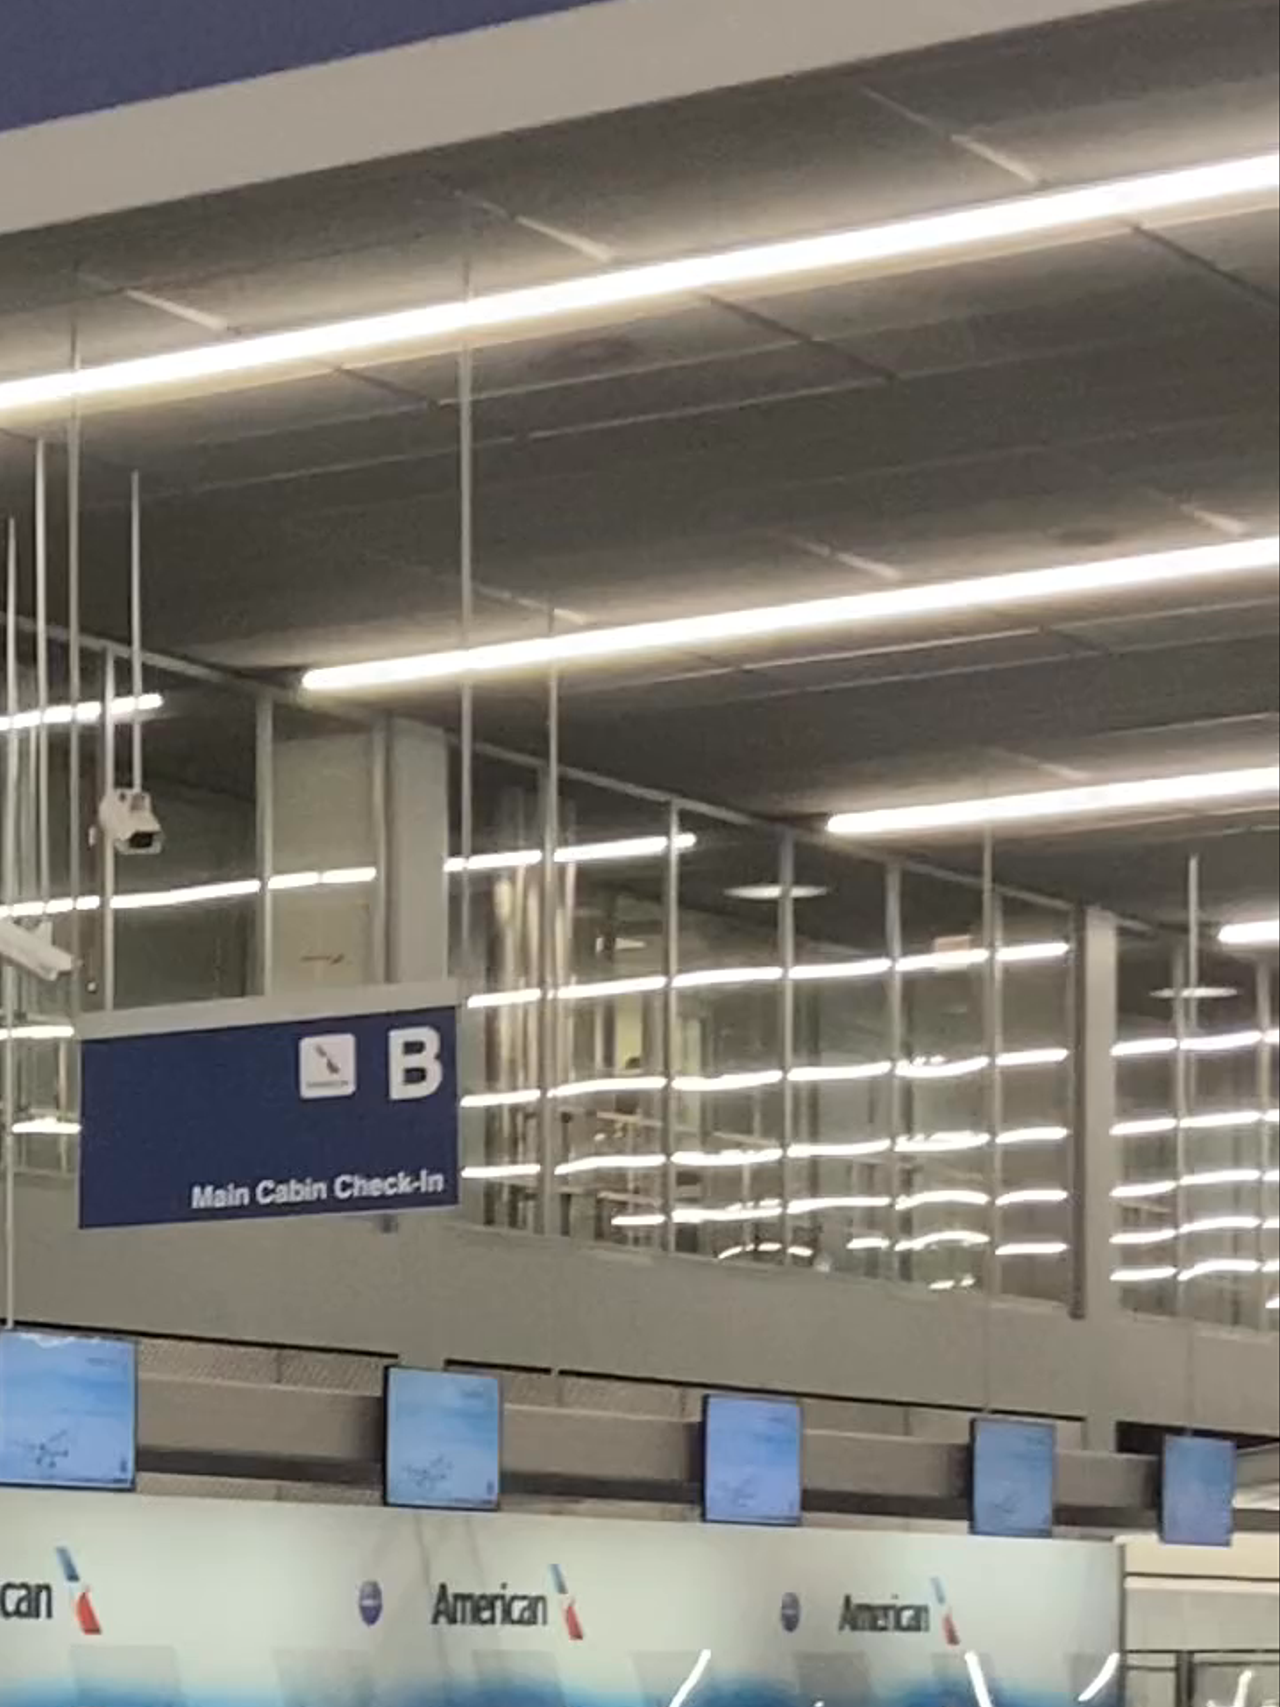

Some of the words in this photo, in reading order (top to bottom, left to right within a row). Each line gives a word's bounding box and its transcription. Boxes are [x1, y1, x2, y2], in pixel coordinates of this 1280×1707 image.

[388, 1026, 443, 1100] B
[191, 1183, 250, 1209] Main
[255, 1177, 327, 1205] Cabin
[333, 1169, 444, 1199] Check-In
[430, 1582, 548, 1626] American
